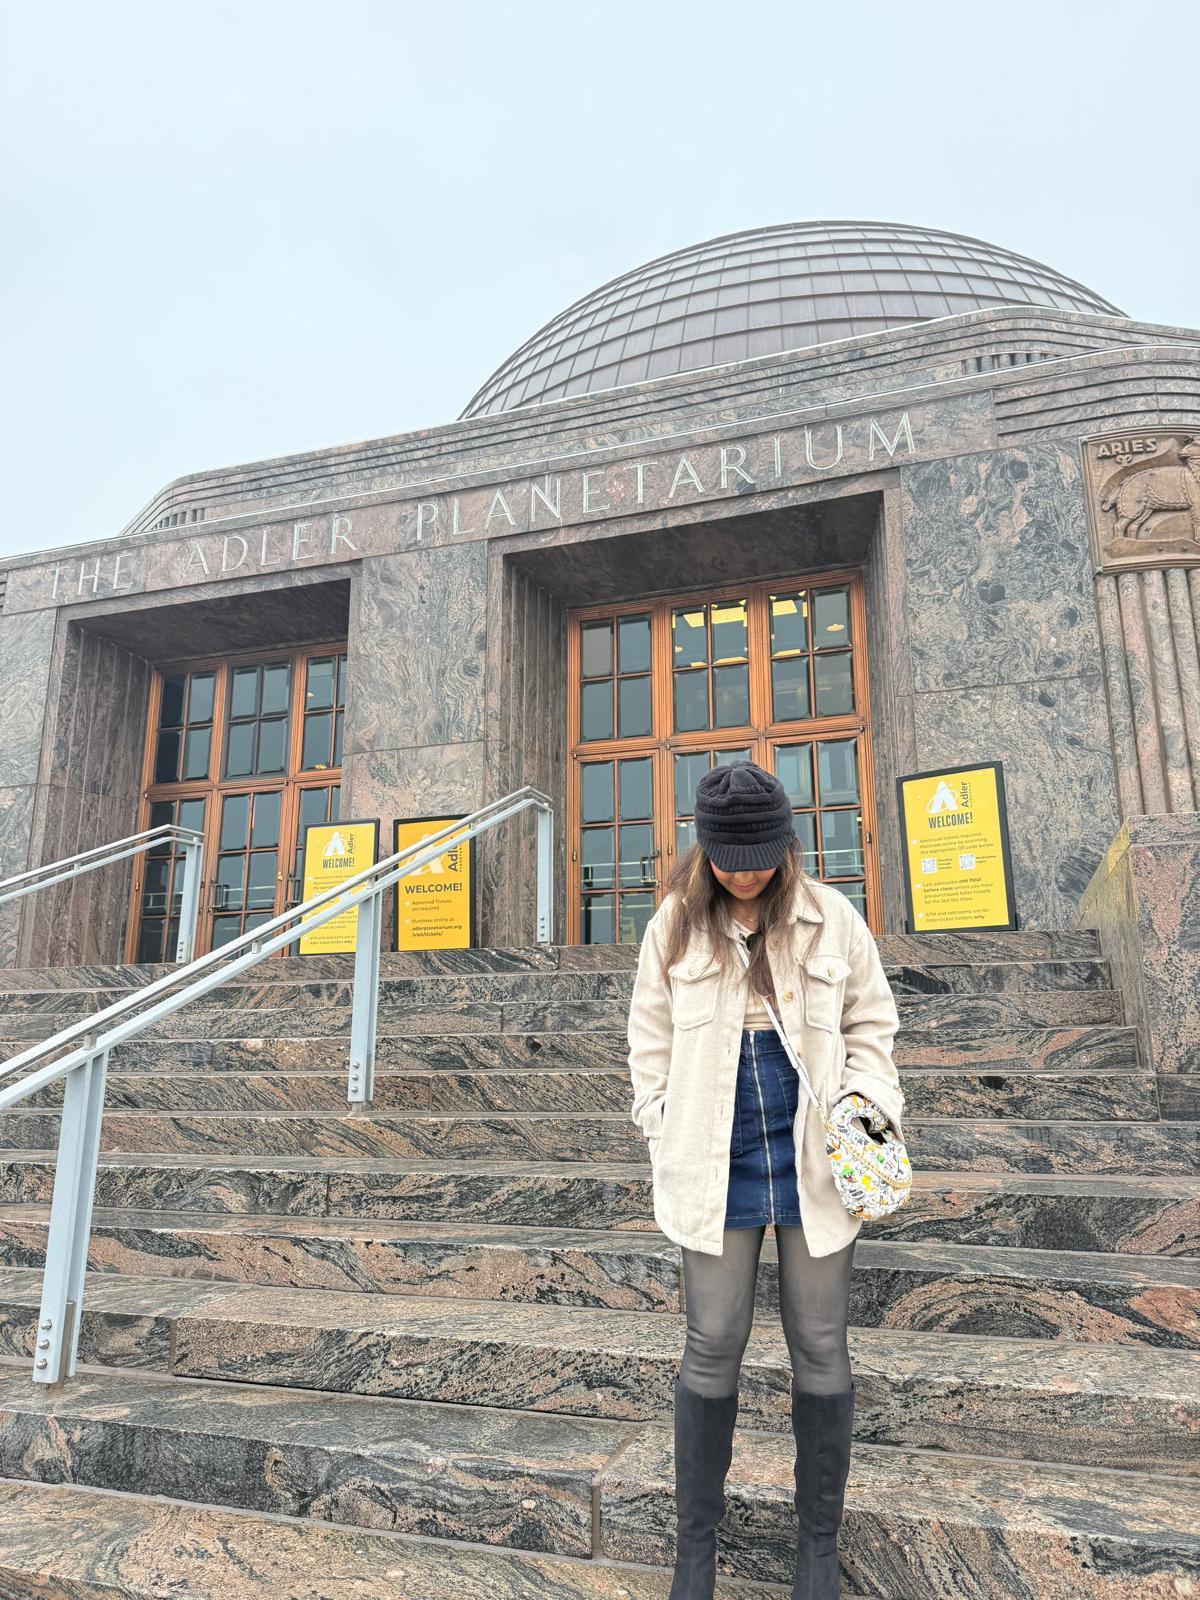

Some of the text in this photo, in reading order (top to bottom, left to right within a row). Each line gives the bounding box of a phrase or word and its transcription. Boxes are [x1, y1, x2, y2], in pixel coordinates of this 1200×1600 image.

[1097, 437, 1157, 458] ARIES
[49, 412, 919, 600] THE ADLER PLANETARIUM
[961, 782, 969, 808] Adler
[928, 812, 973, 829] WELCOME!
[322, 857, 355, 869] WELCOME!
[404, 882, 462, 894] WELCOME!
